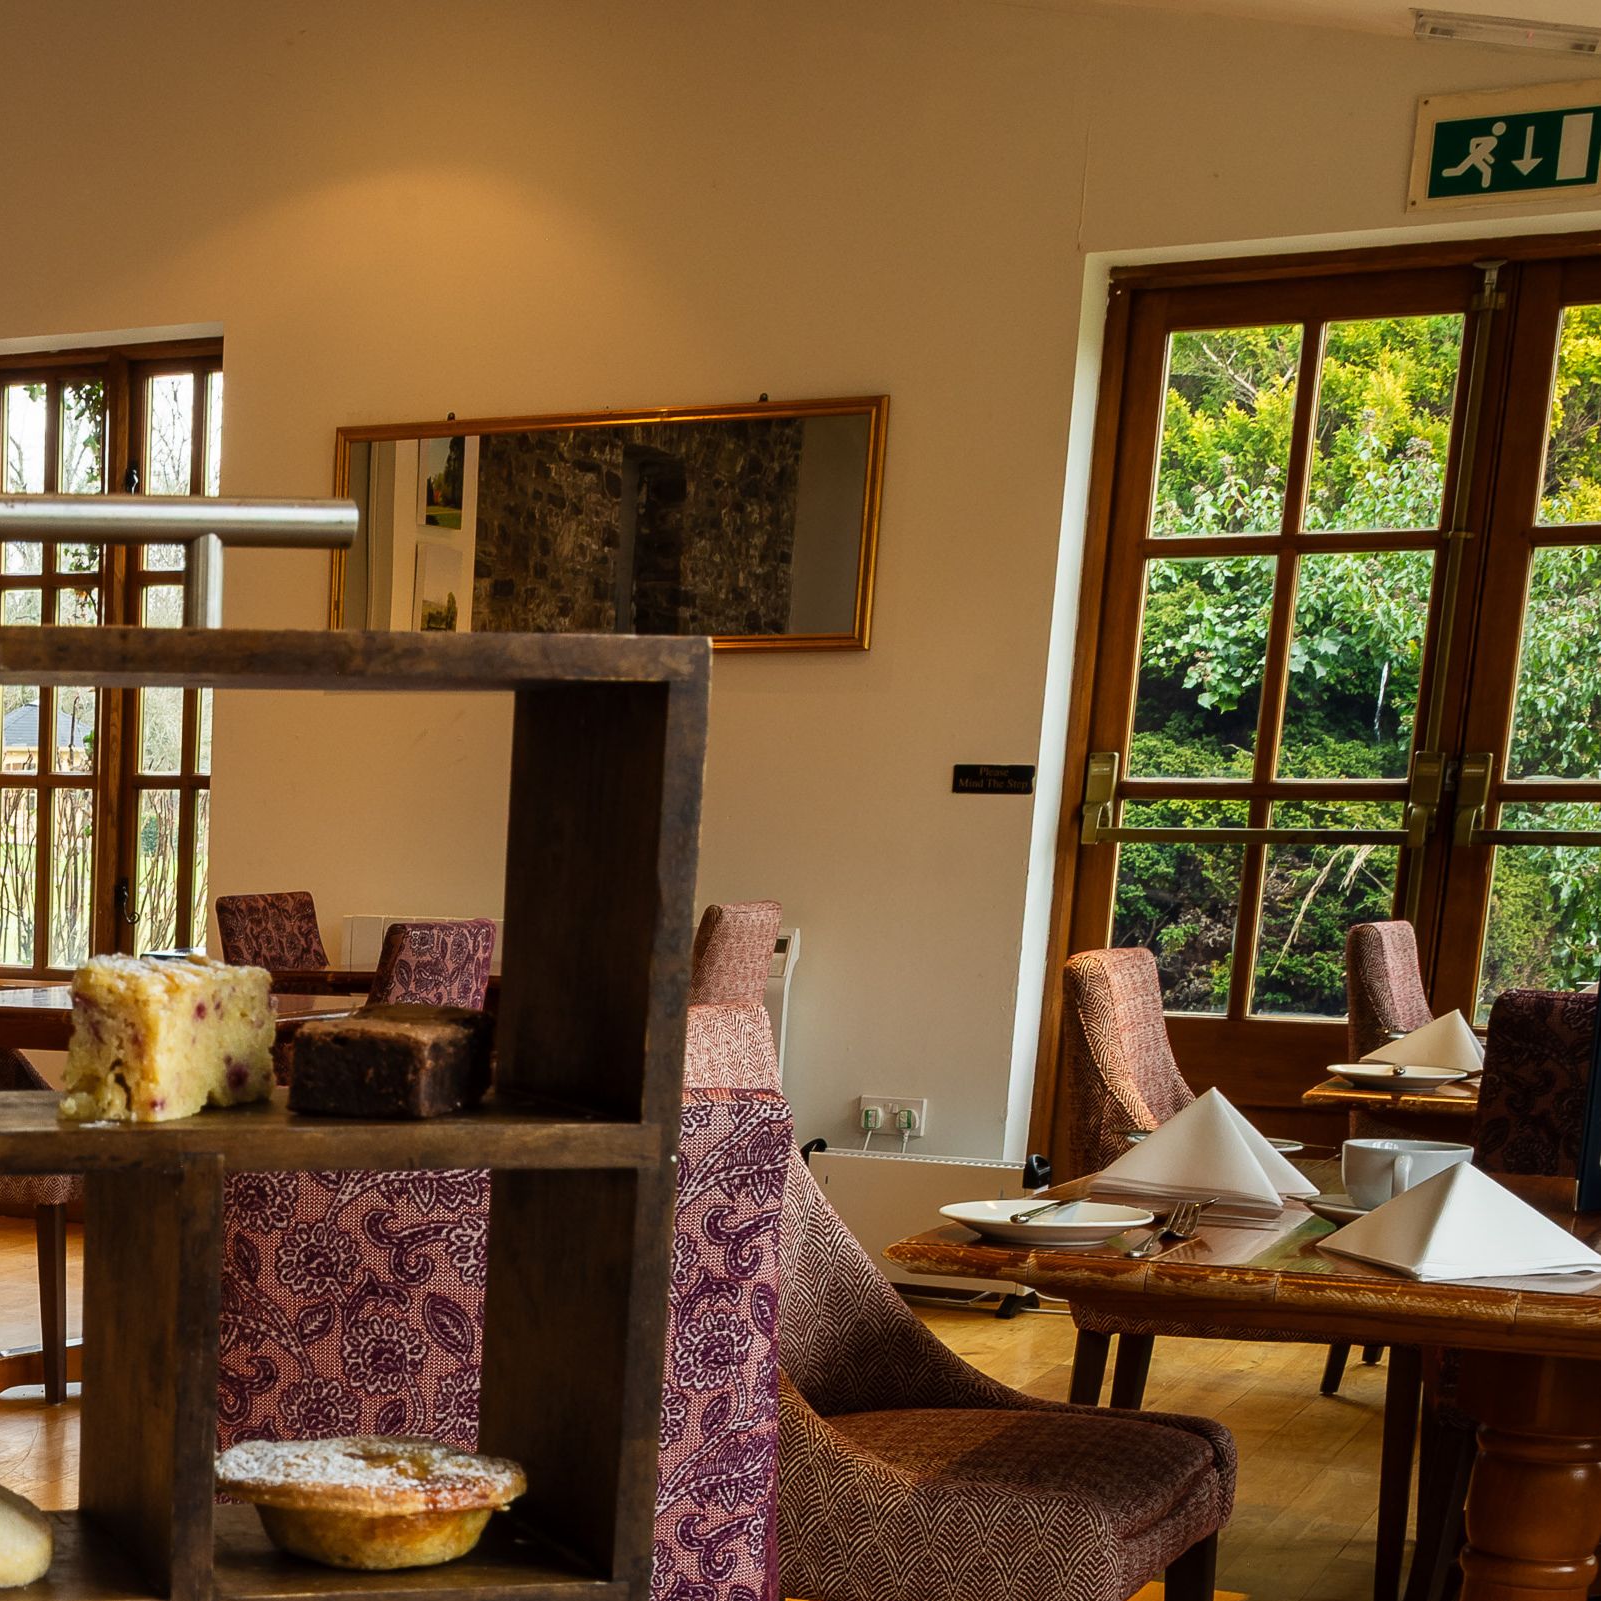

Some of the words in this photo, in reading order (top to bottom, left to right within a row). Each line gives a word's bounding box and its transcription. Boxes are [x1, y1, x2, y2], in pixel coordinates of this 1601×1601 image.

[979, 766, 1009, 777] Please
[958, 777, 983, 788] Mind
[987, 778, 1005, 788] The
[1007, 778, 1029, 791] Step
